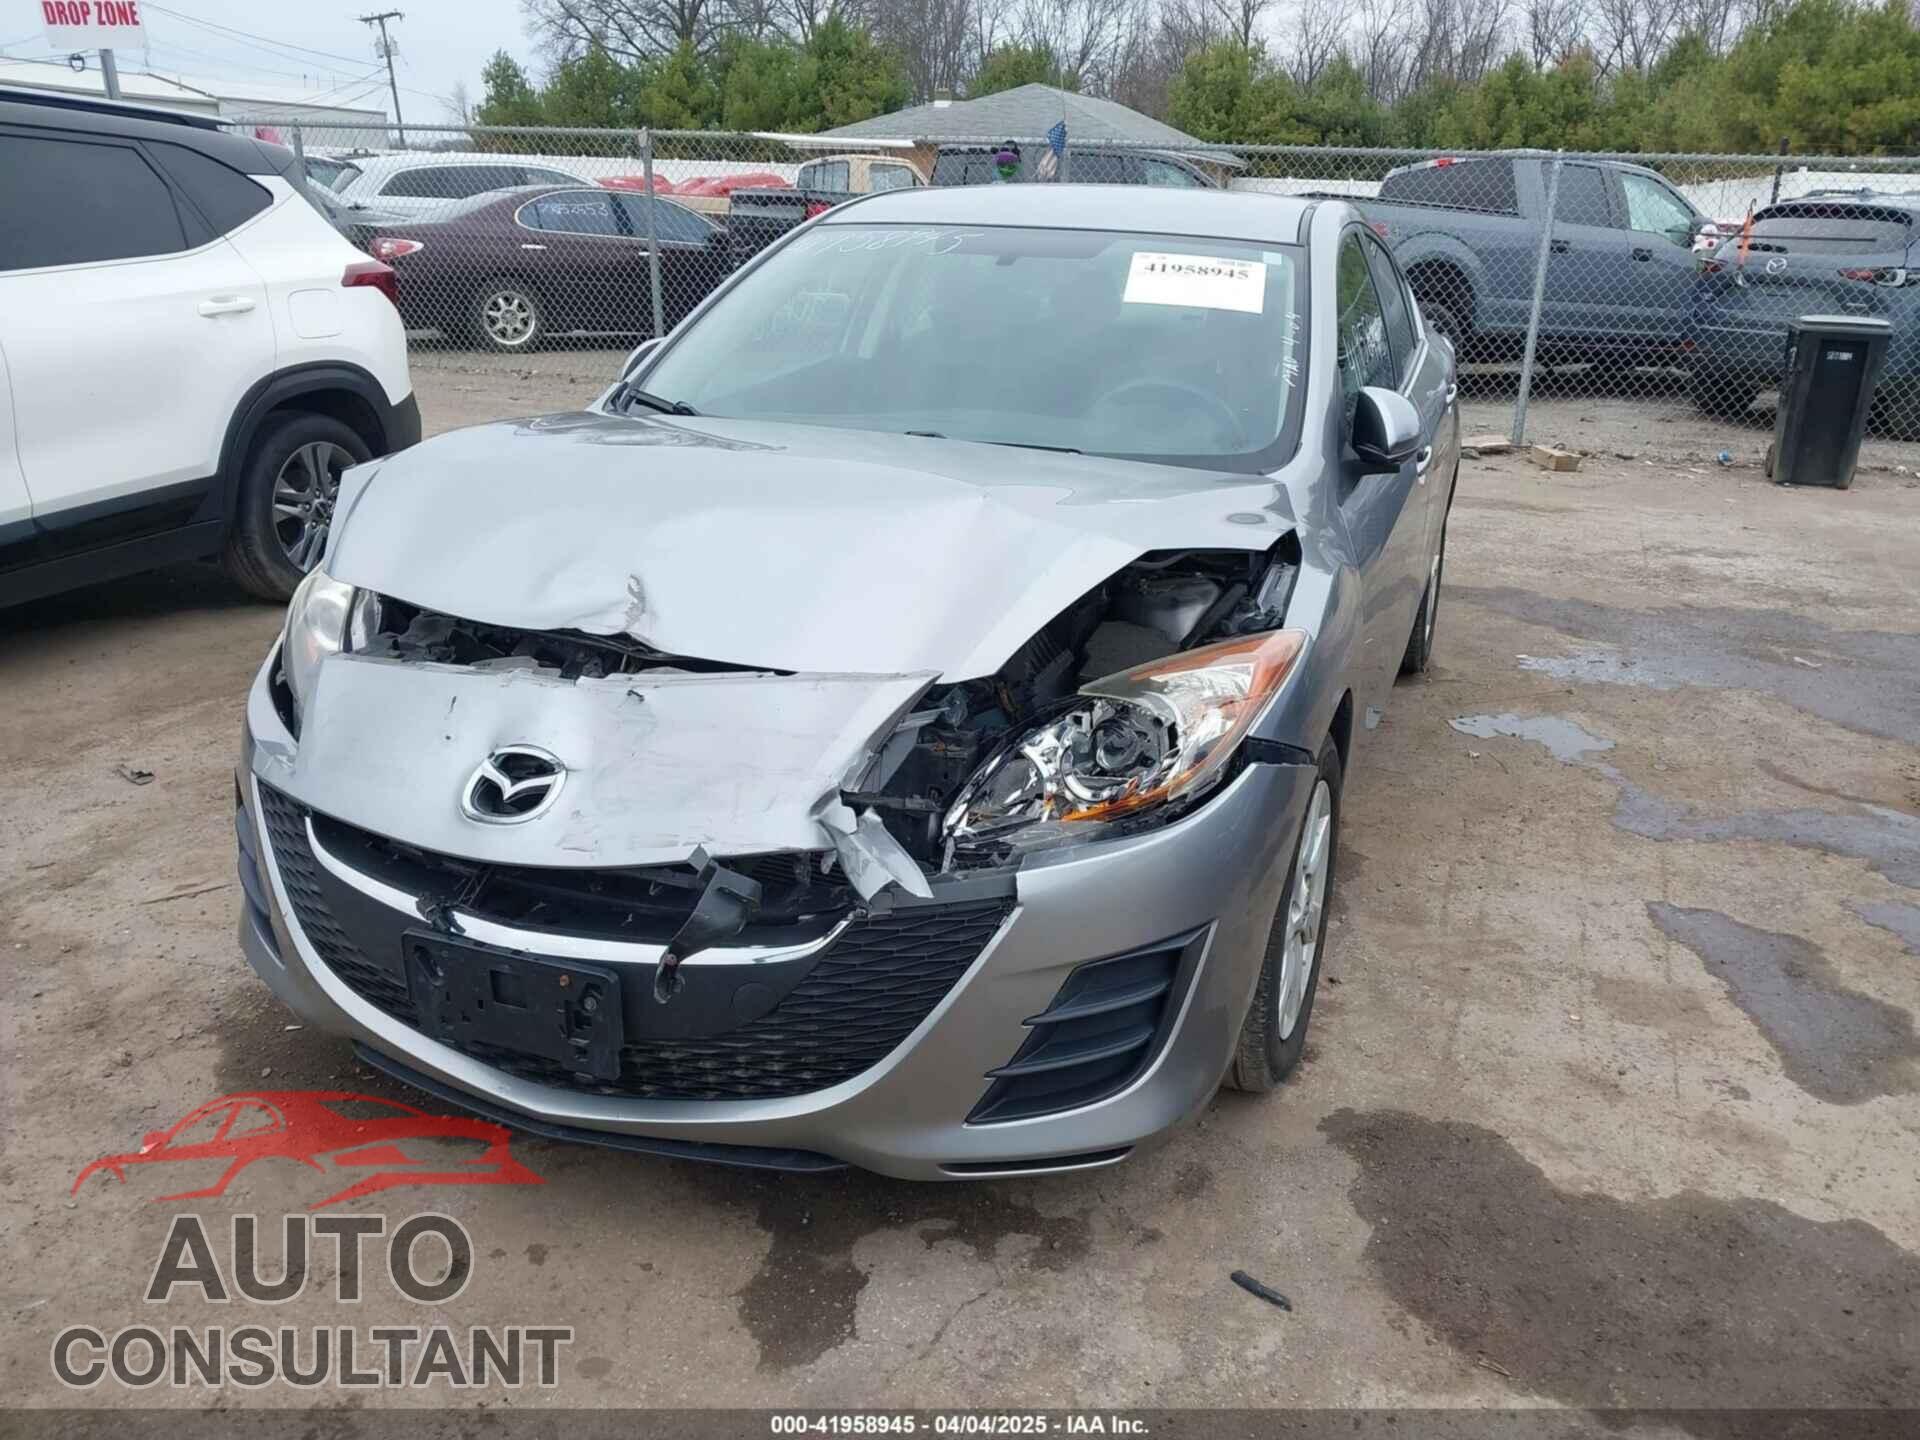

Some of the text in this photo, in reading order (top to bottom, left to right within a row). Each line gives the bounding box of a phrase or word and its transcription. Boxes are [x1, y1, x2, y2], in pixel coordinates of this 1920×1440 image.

[42, 1, 140, 26] DROP ZONE
[1144, 263, 1250, 281] 41958945
